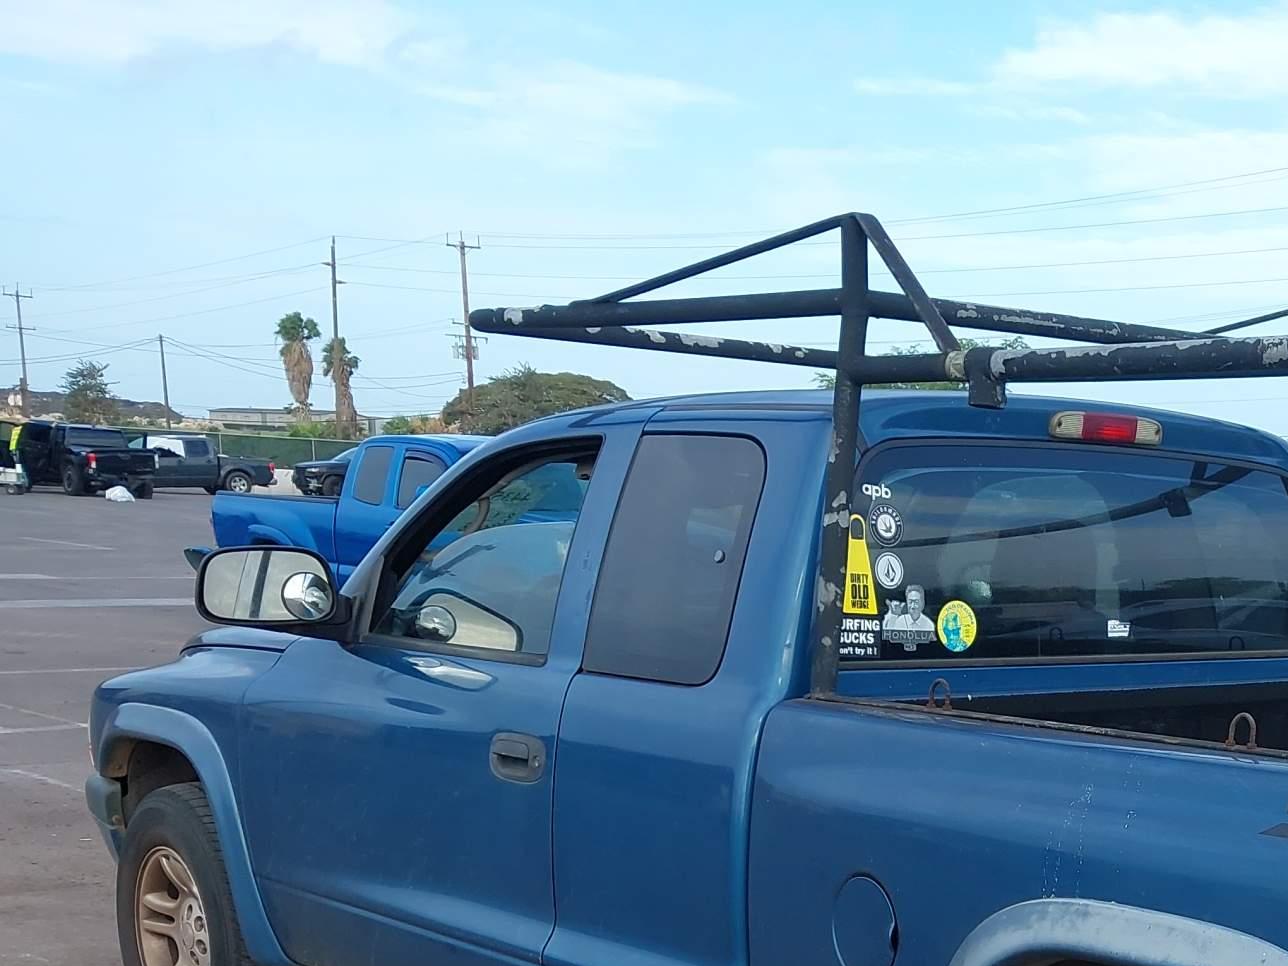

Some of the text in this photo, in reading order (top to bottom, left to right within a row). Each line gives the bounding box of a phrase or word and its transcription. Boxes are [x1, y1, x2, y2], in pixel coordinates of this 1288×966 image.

[862, 484, 892, 500] apb
[850, 573, 868, 584] DIRTY
[851, 584, 869, 600] OLD
[841, 619, 881, 631] URFING
[883, 630, 936, 641] HONOLUA
[839, 646, 854, 655] on't
[855, 646, 866, 656] try
